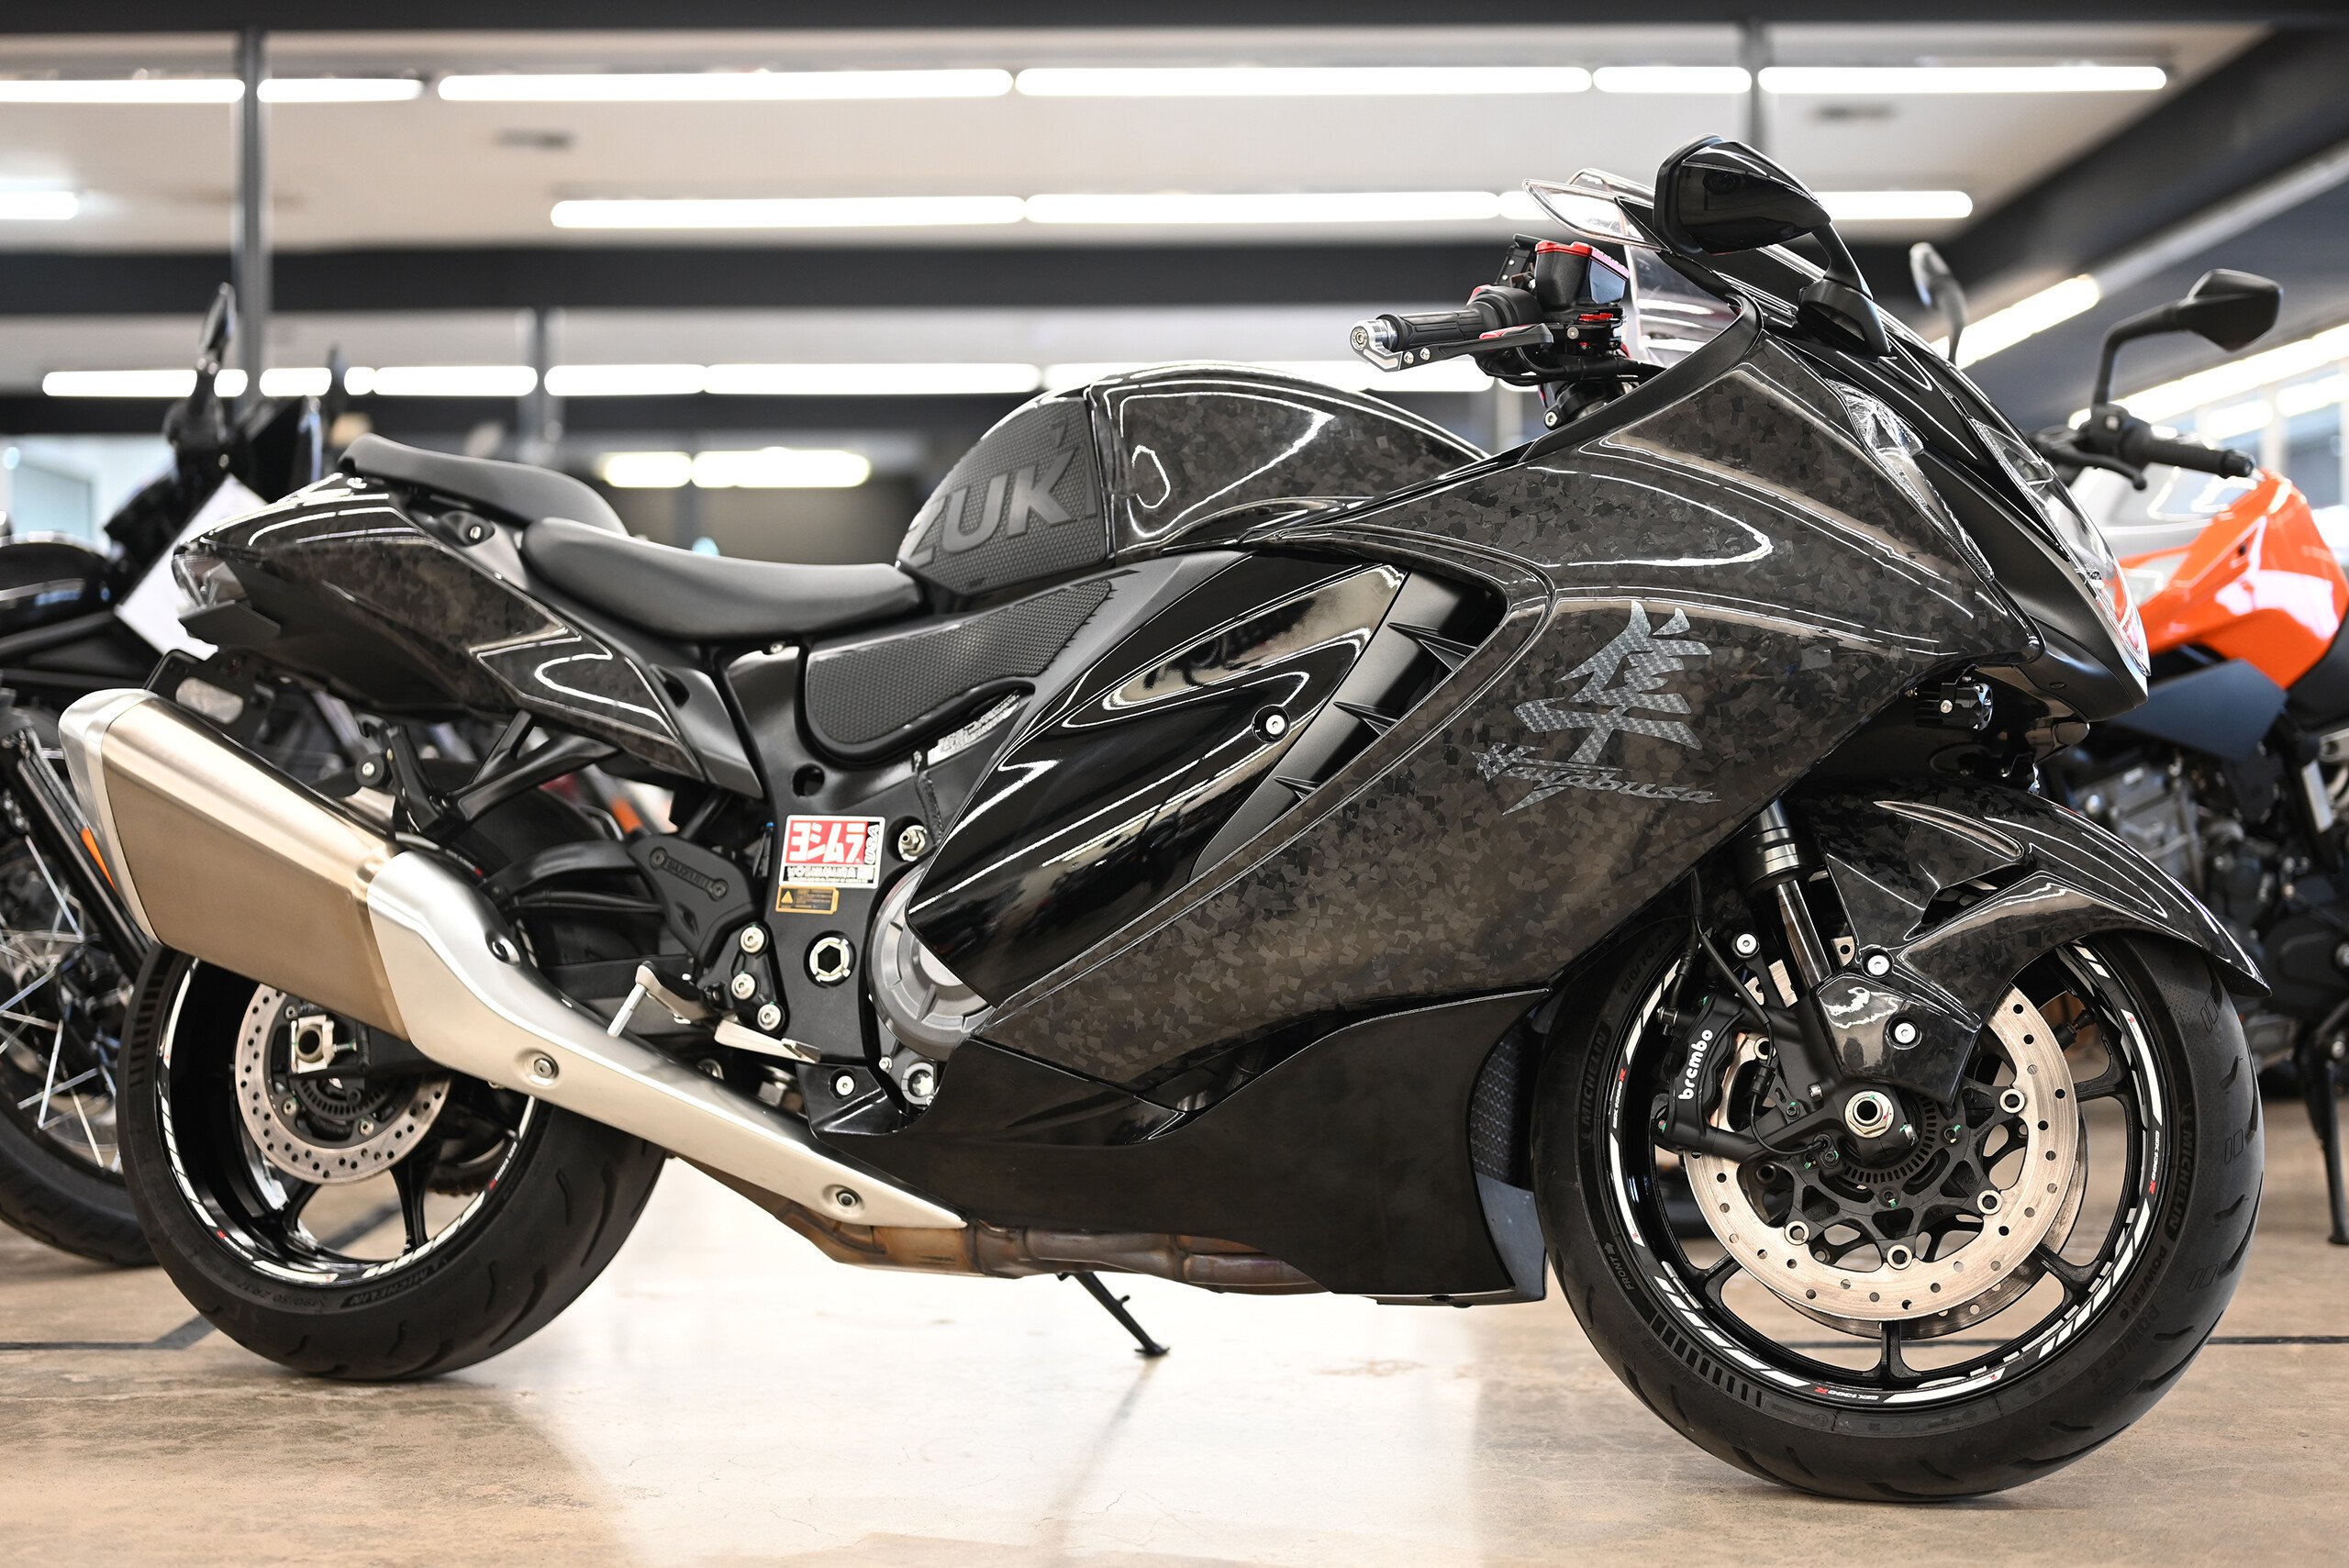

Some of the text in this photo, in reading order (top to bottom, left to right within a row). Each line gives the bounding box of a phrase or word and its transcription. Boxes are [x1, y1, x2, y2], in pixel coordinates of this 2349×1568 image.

[1514, 599, 1713, 764] 隼
[788, 822, 866, 863] ヨシムラ
[863, 824, 880, 864] USA
[1580, 1030, 1607, 1125] MICHELIN
[1677, 1029, 1714, 1100] brembo
[2166, 1129, 2193, 1230] MICHELIN
[1609, 1255, 1634, 1291] FRONT
